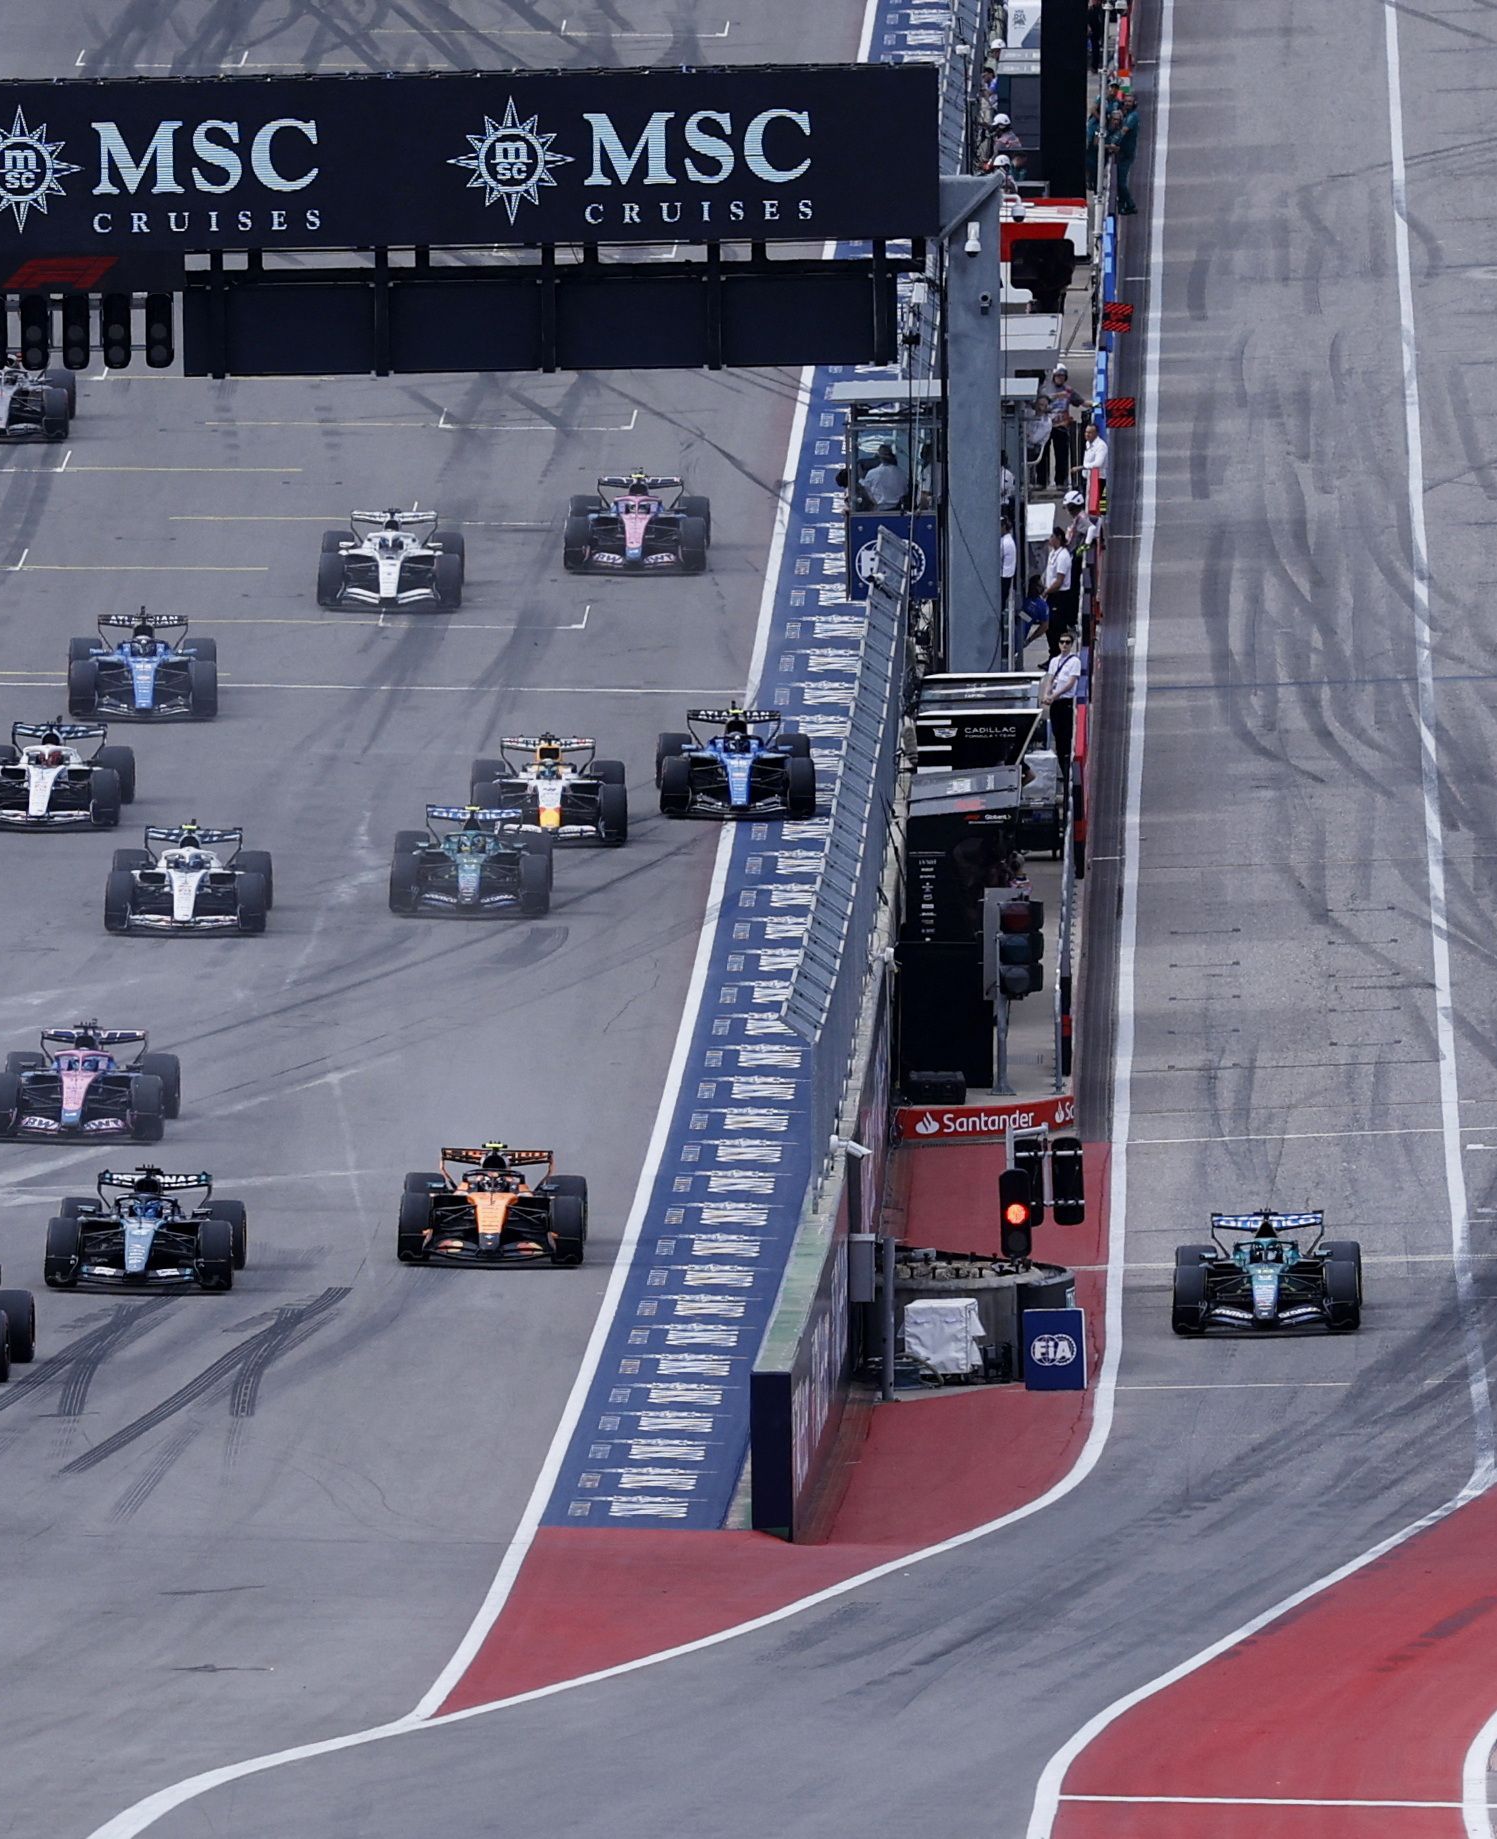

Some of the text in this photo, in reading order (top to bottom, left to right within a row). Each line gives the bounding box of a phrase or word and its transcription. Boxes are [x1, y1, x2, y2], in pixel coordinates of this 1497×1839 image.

[91, 119, 319, 195] MSC
[583, 109, 812, 185] MSC
[93, 210, 321, 232] CRUISES
[585, 200, 813, 224] CRUISES
[109, 615, 179, 625] ATLAIAN
[698, 710, 770, 720] ATLAIAN
[943, 1110, 1034, 1133] Santander
[112, 1174, 198, 1187] PETNAS
